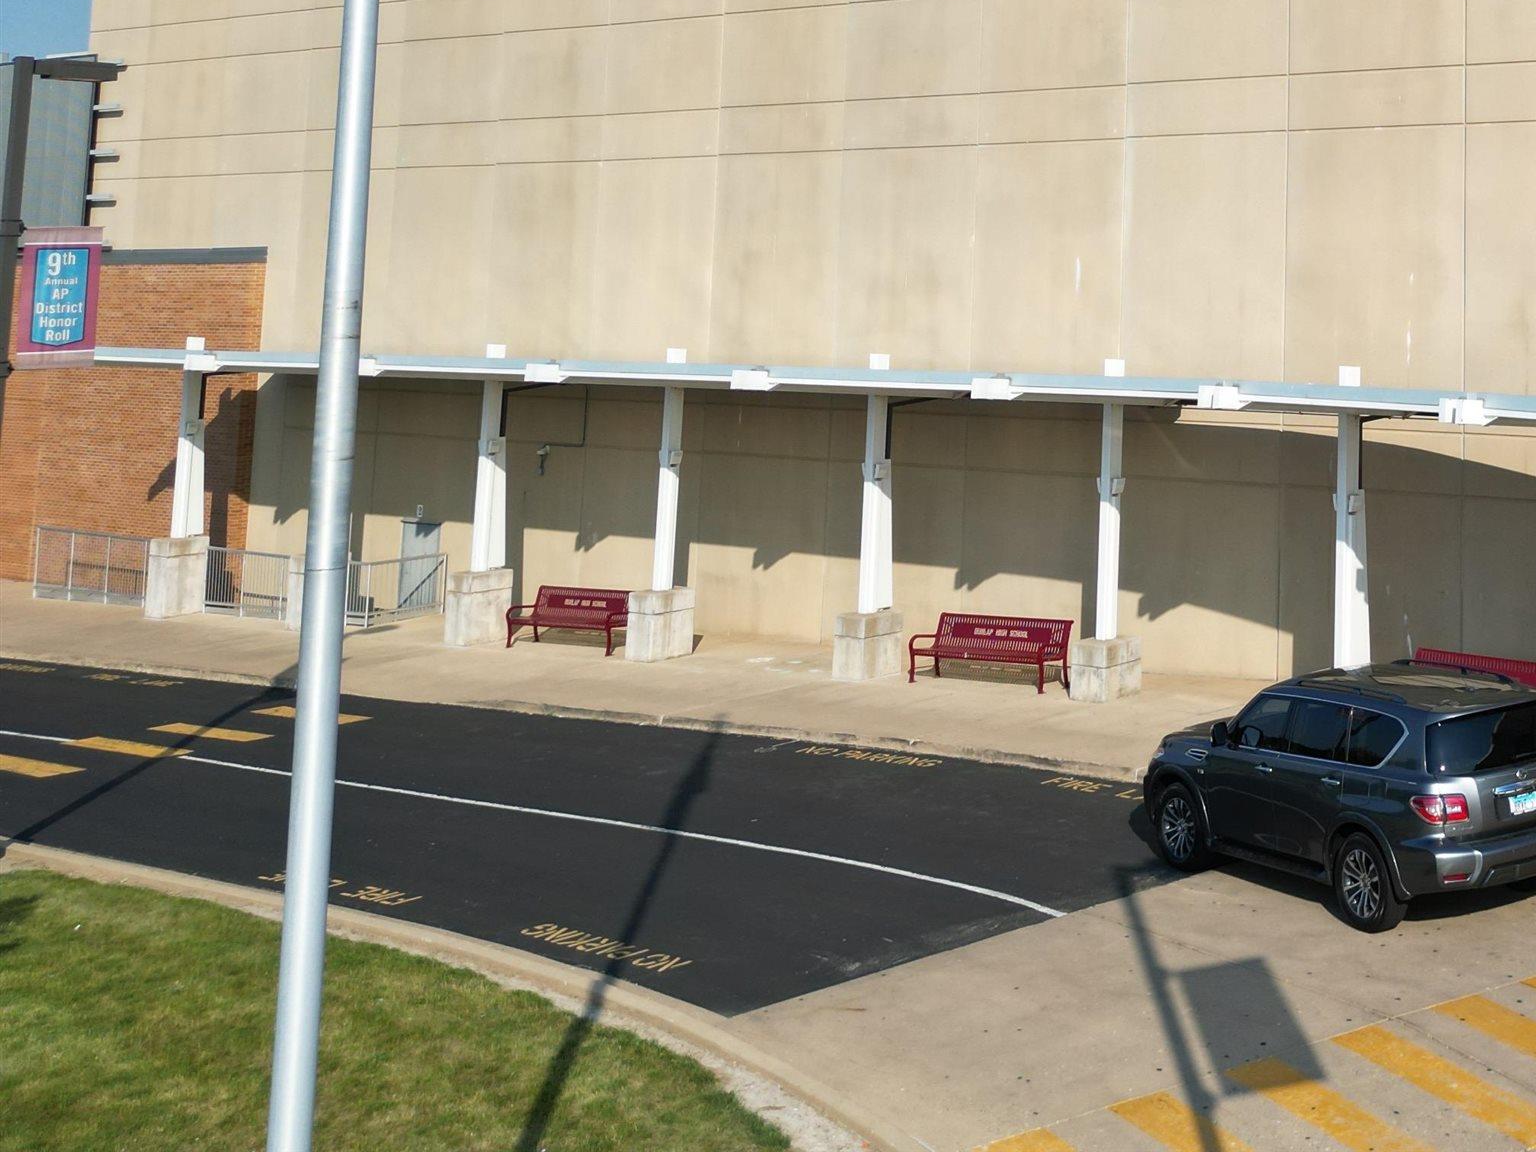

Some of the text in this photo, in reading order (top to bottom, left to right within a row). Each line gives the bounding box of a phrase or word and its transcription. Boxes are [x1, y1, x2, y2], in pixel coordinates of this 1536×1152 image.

[48, 252, 76, 276] 9th
[44, 277, 78, 285] Annual
[52, 288, 70, 300] AP
[36, 302, 83, 314] District
[39, 315, 78, 327] Honor
[45, 329, 70, 341] Roll
[796, 746, 839, 756] NO
[1040, 776, 1113, 793] FIRE
[339, 885, 423, 906] FIRE
[520, 923, 693, 973] NO PARKING
